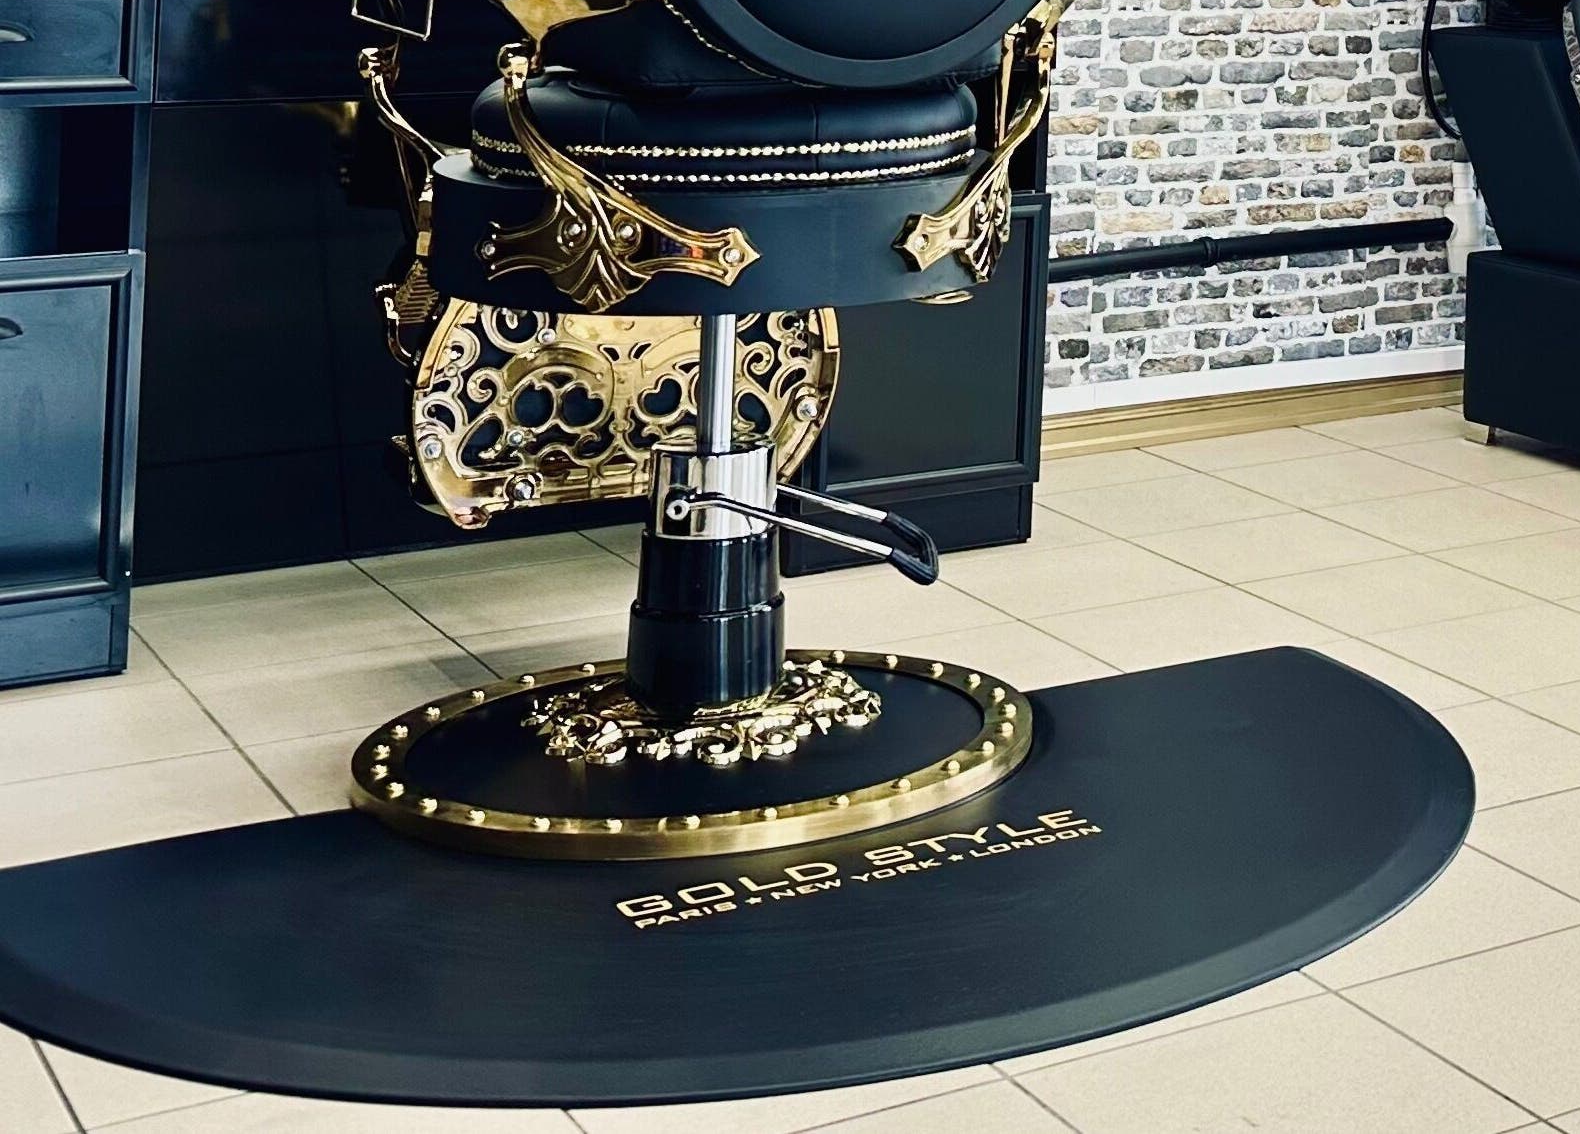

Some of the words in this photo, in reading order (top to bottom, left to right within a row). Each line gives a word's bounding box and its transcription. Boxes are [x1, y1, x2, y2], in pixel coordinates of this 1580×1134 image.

[617, 862, 838, 917] GOLD
[864, 809, 1088, 866] STYLE
[635, 901, 737, 929] PARIS
[770, 878, 841, 900] NEW
[850, 858, 942, 882] YORK
[969, 825, 1102, 858] LONDON
